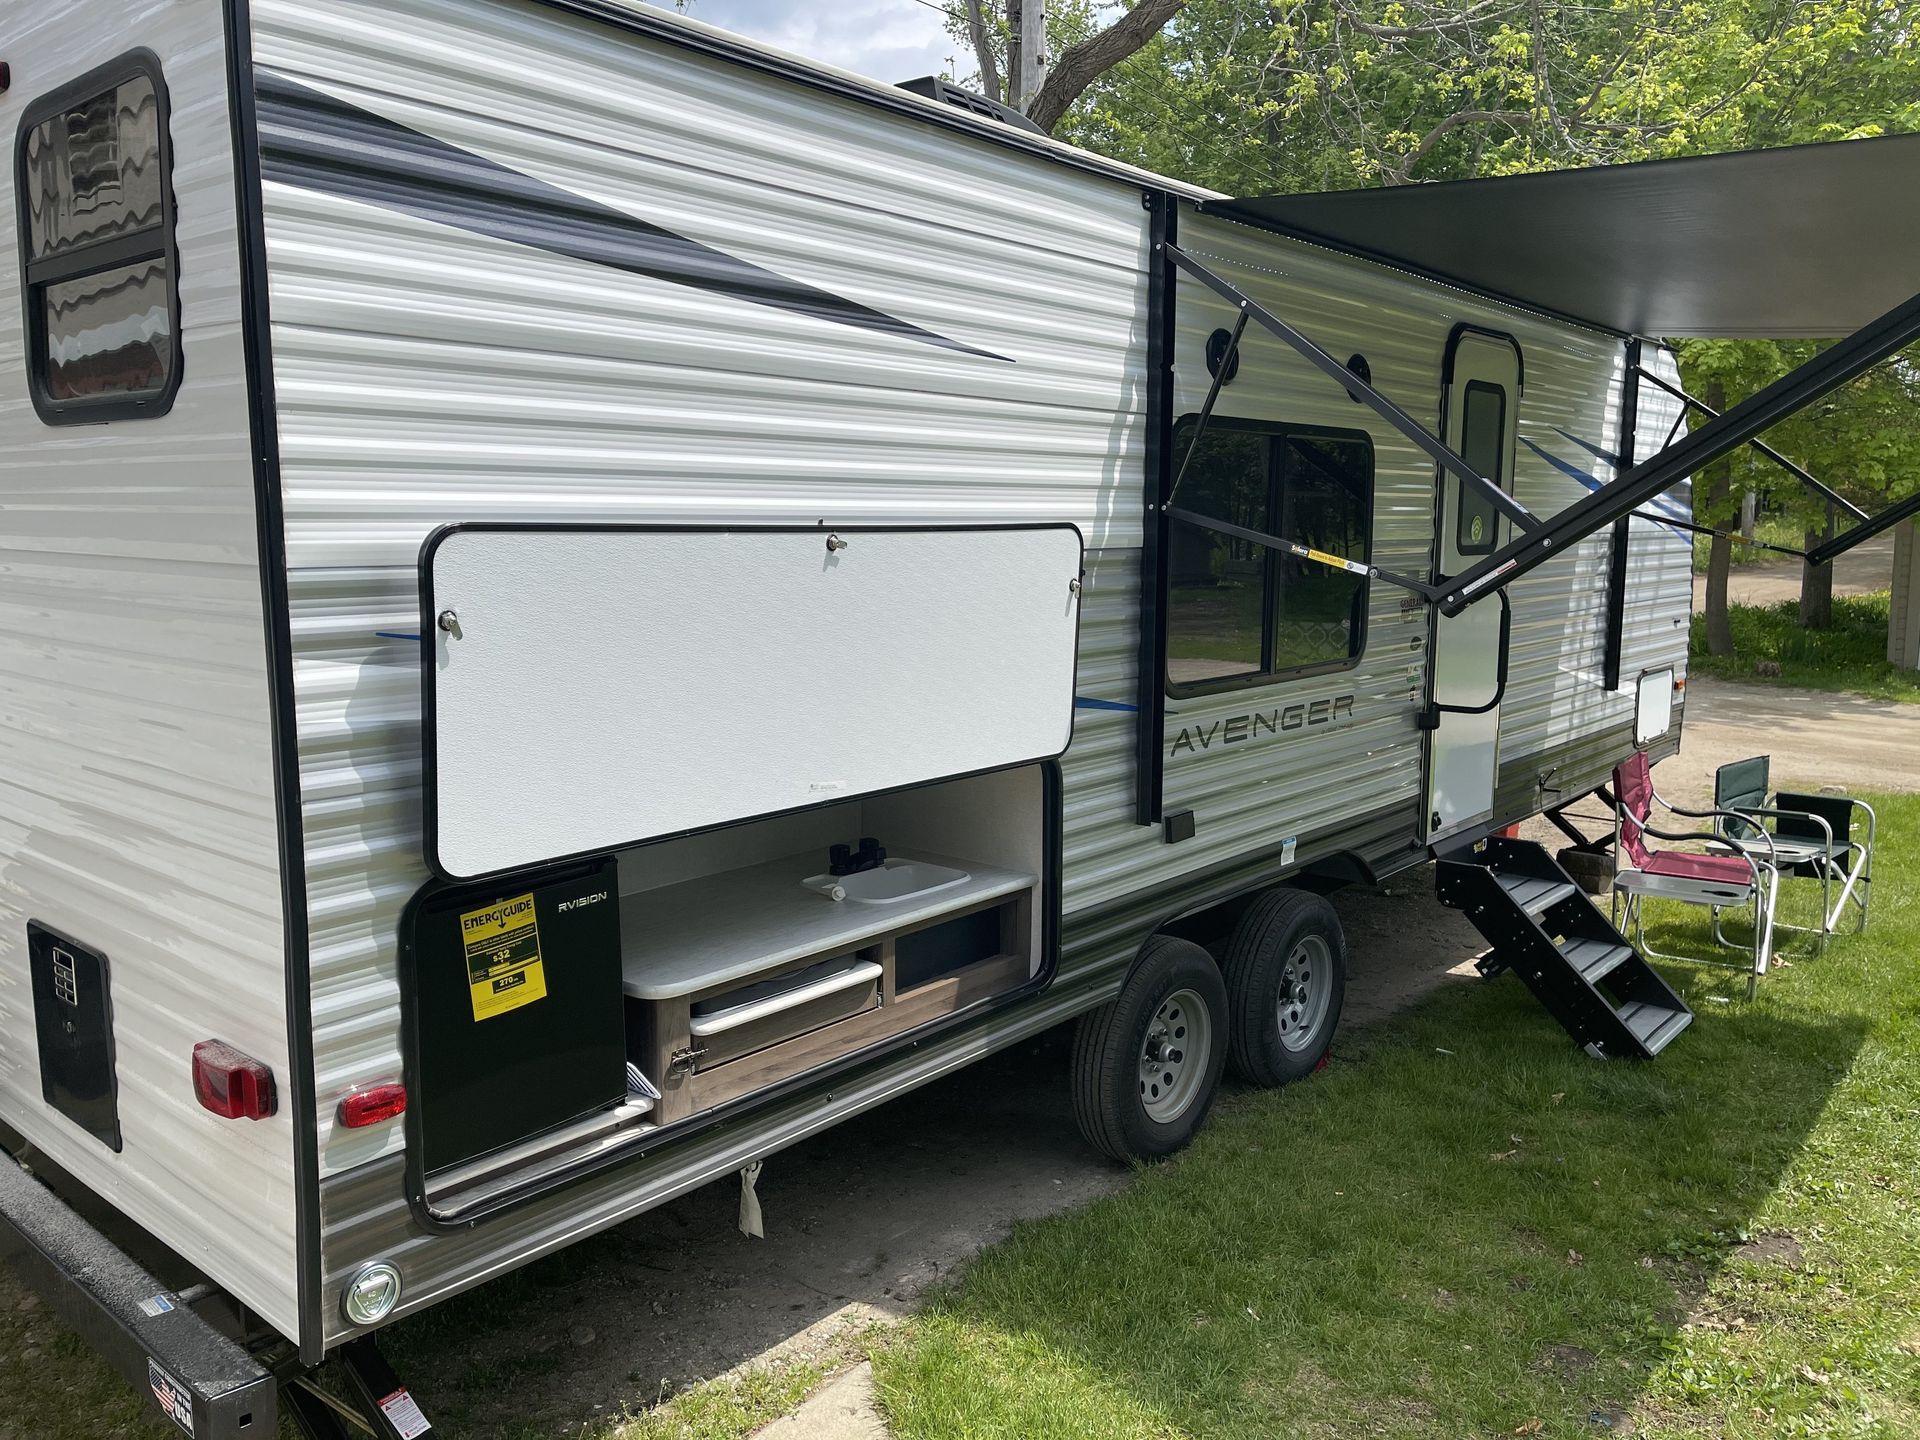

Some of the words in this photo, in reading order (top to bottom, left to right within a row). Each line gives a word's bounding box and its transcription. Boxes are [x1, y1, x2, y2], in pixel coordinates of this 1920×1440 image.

[1170, 695, 1355, 757] AVENGER
[558, 891, 607, 913] RVISION
[499, 976, 514, 987] 270
[174, 1400, 193, 1431] USA
